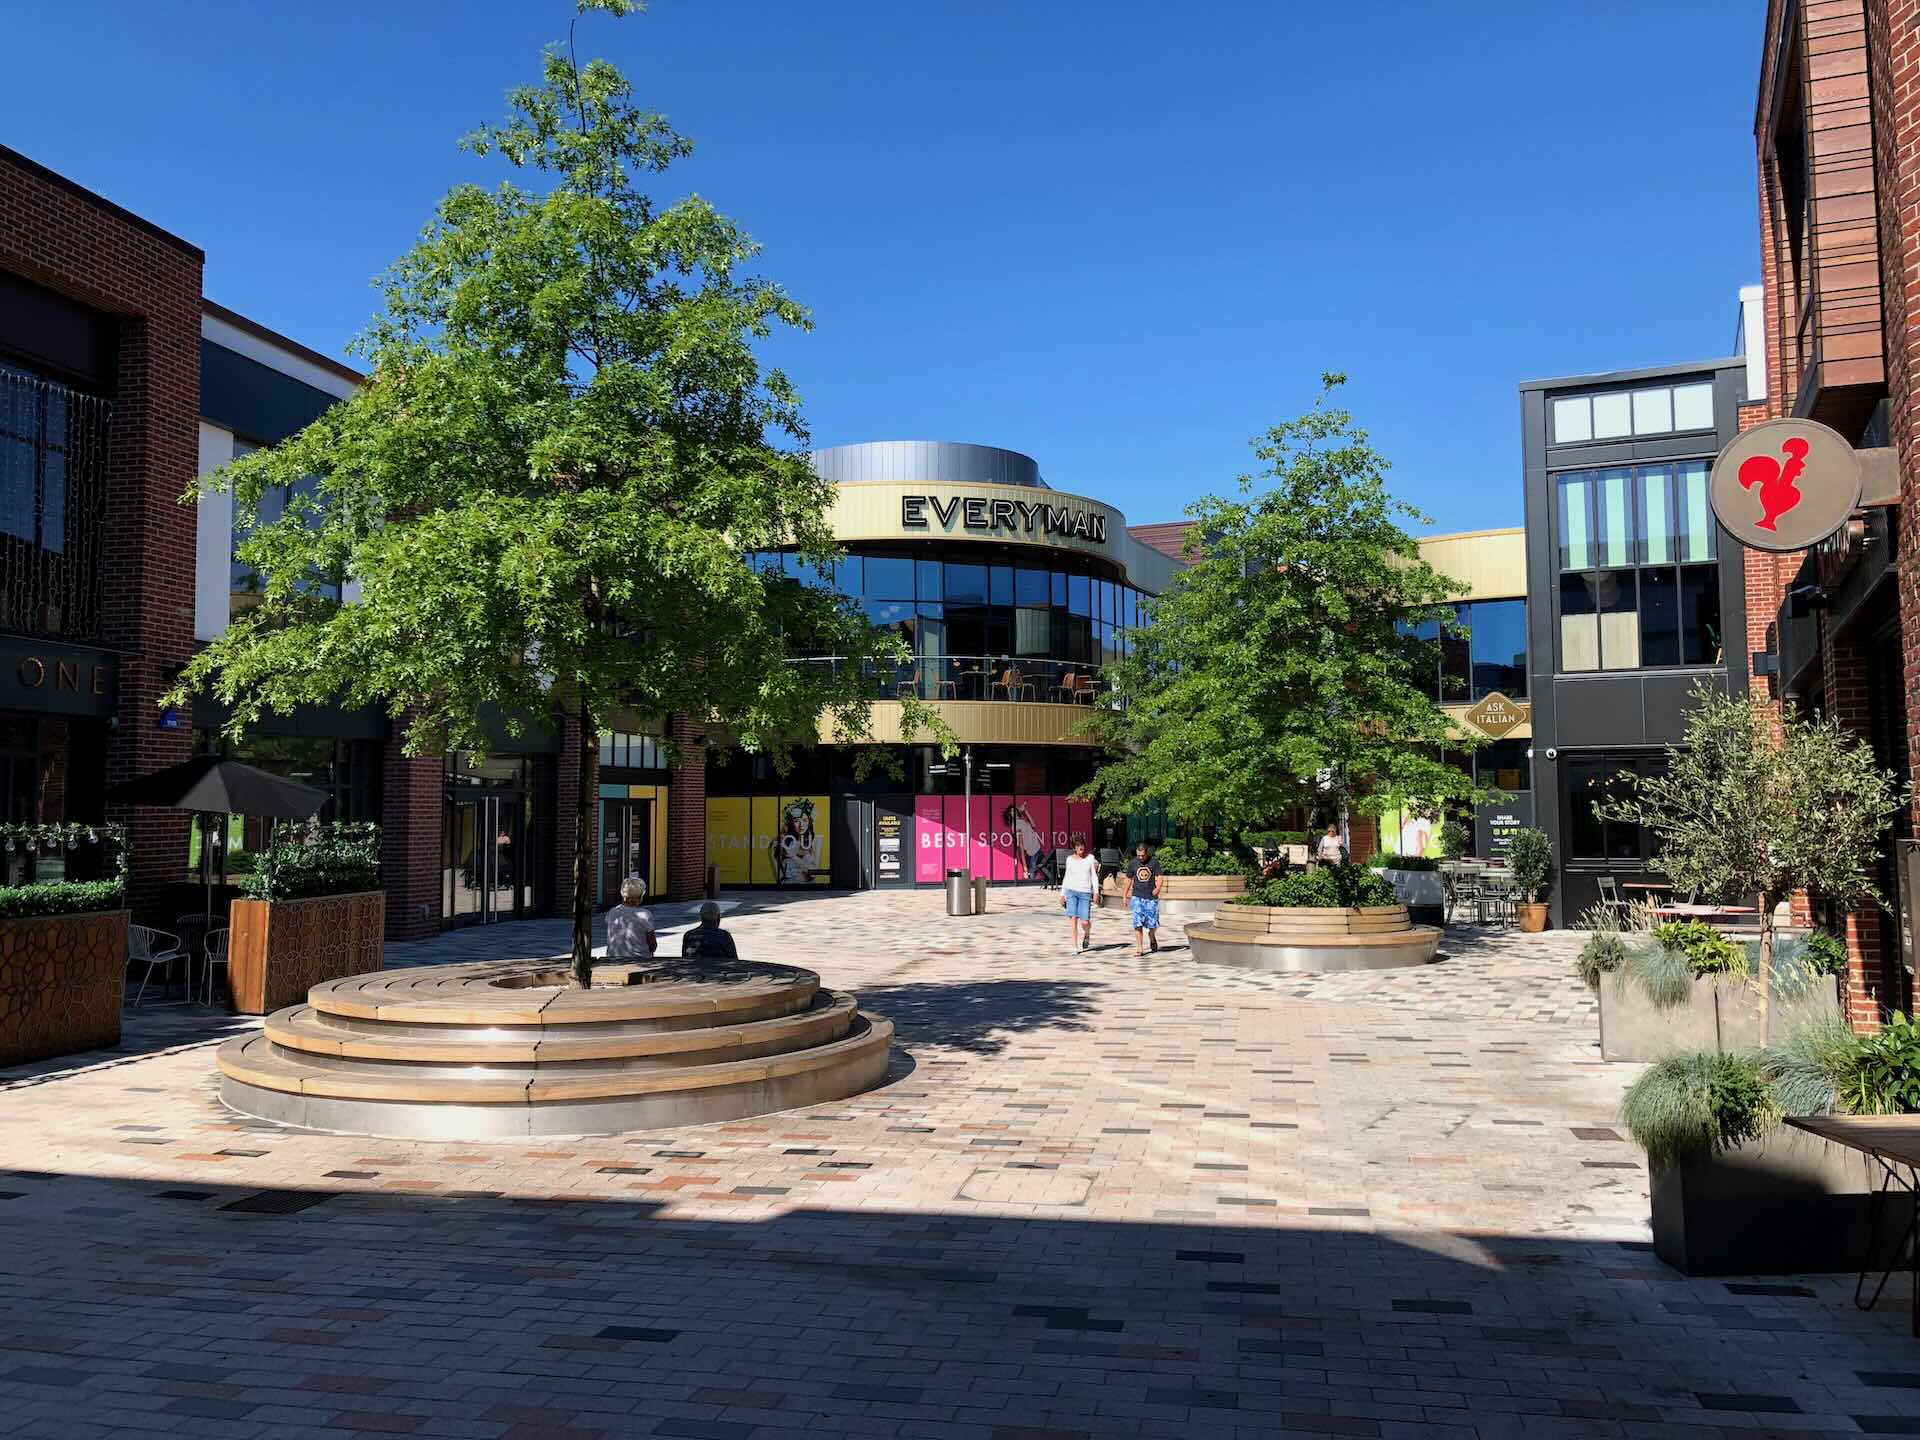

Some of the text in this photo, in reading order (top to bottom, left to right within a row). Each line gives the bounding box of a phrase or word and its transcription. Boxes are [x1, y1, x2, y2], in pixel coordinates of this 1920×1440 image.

[902, 496, 1106, 544] EVERYMAN
[17, 656, 105, 695] ONE
[1487, 702, 1505, 712] ASK
[1476, 713, 1515, 724] ITALIAN
[782, 834, 824, 850] OUT
[921, 832, 967, 849] BEST
[978, 831, 1024, 848] SPOT
